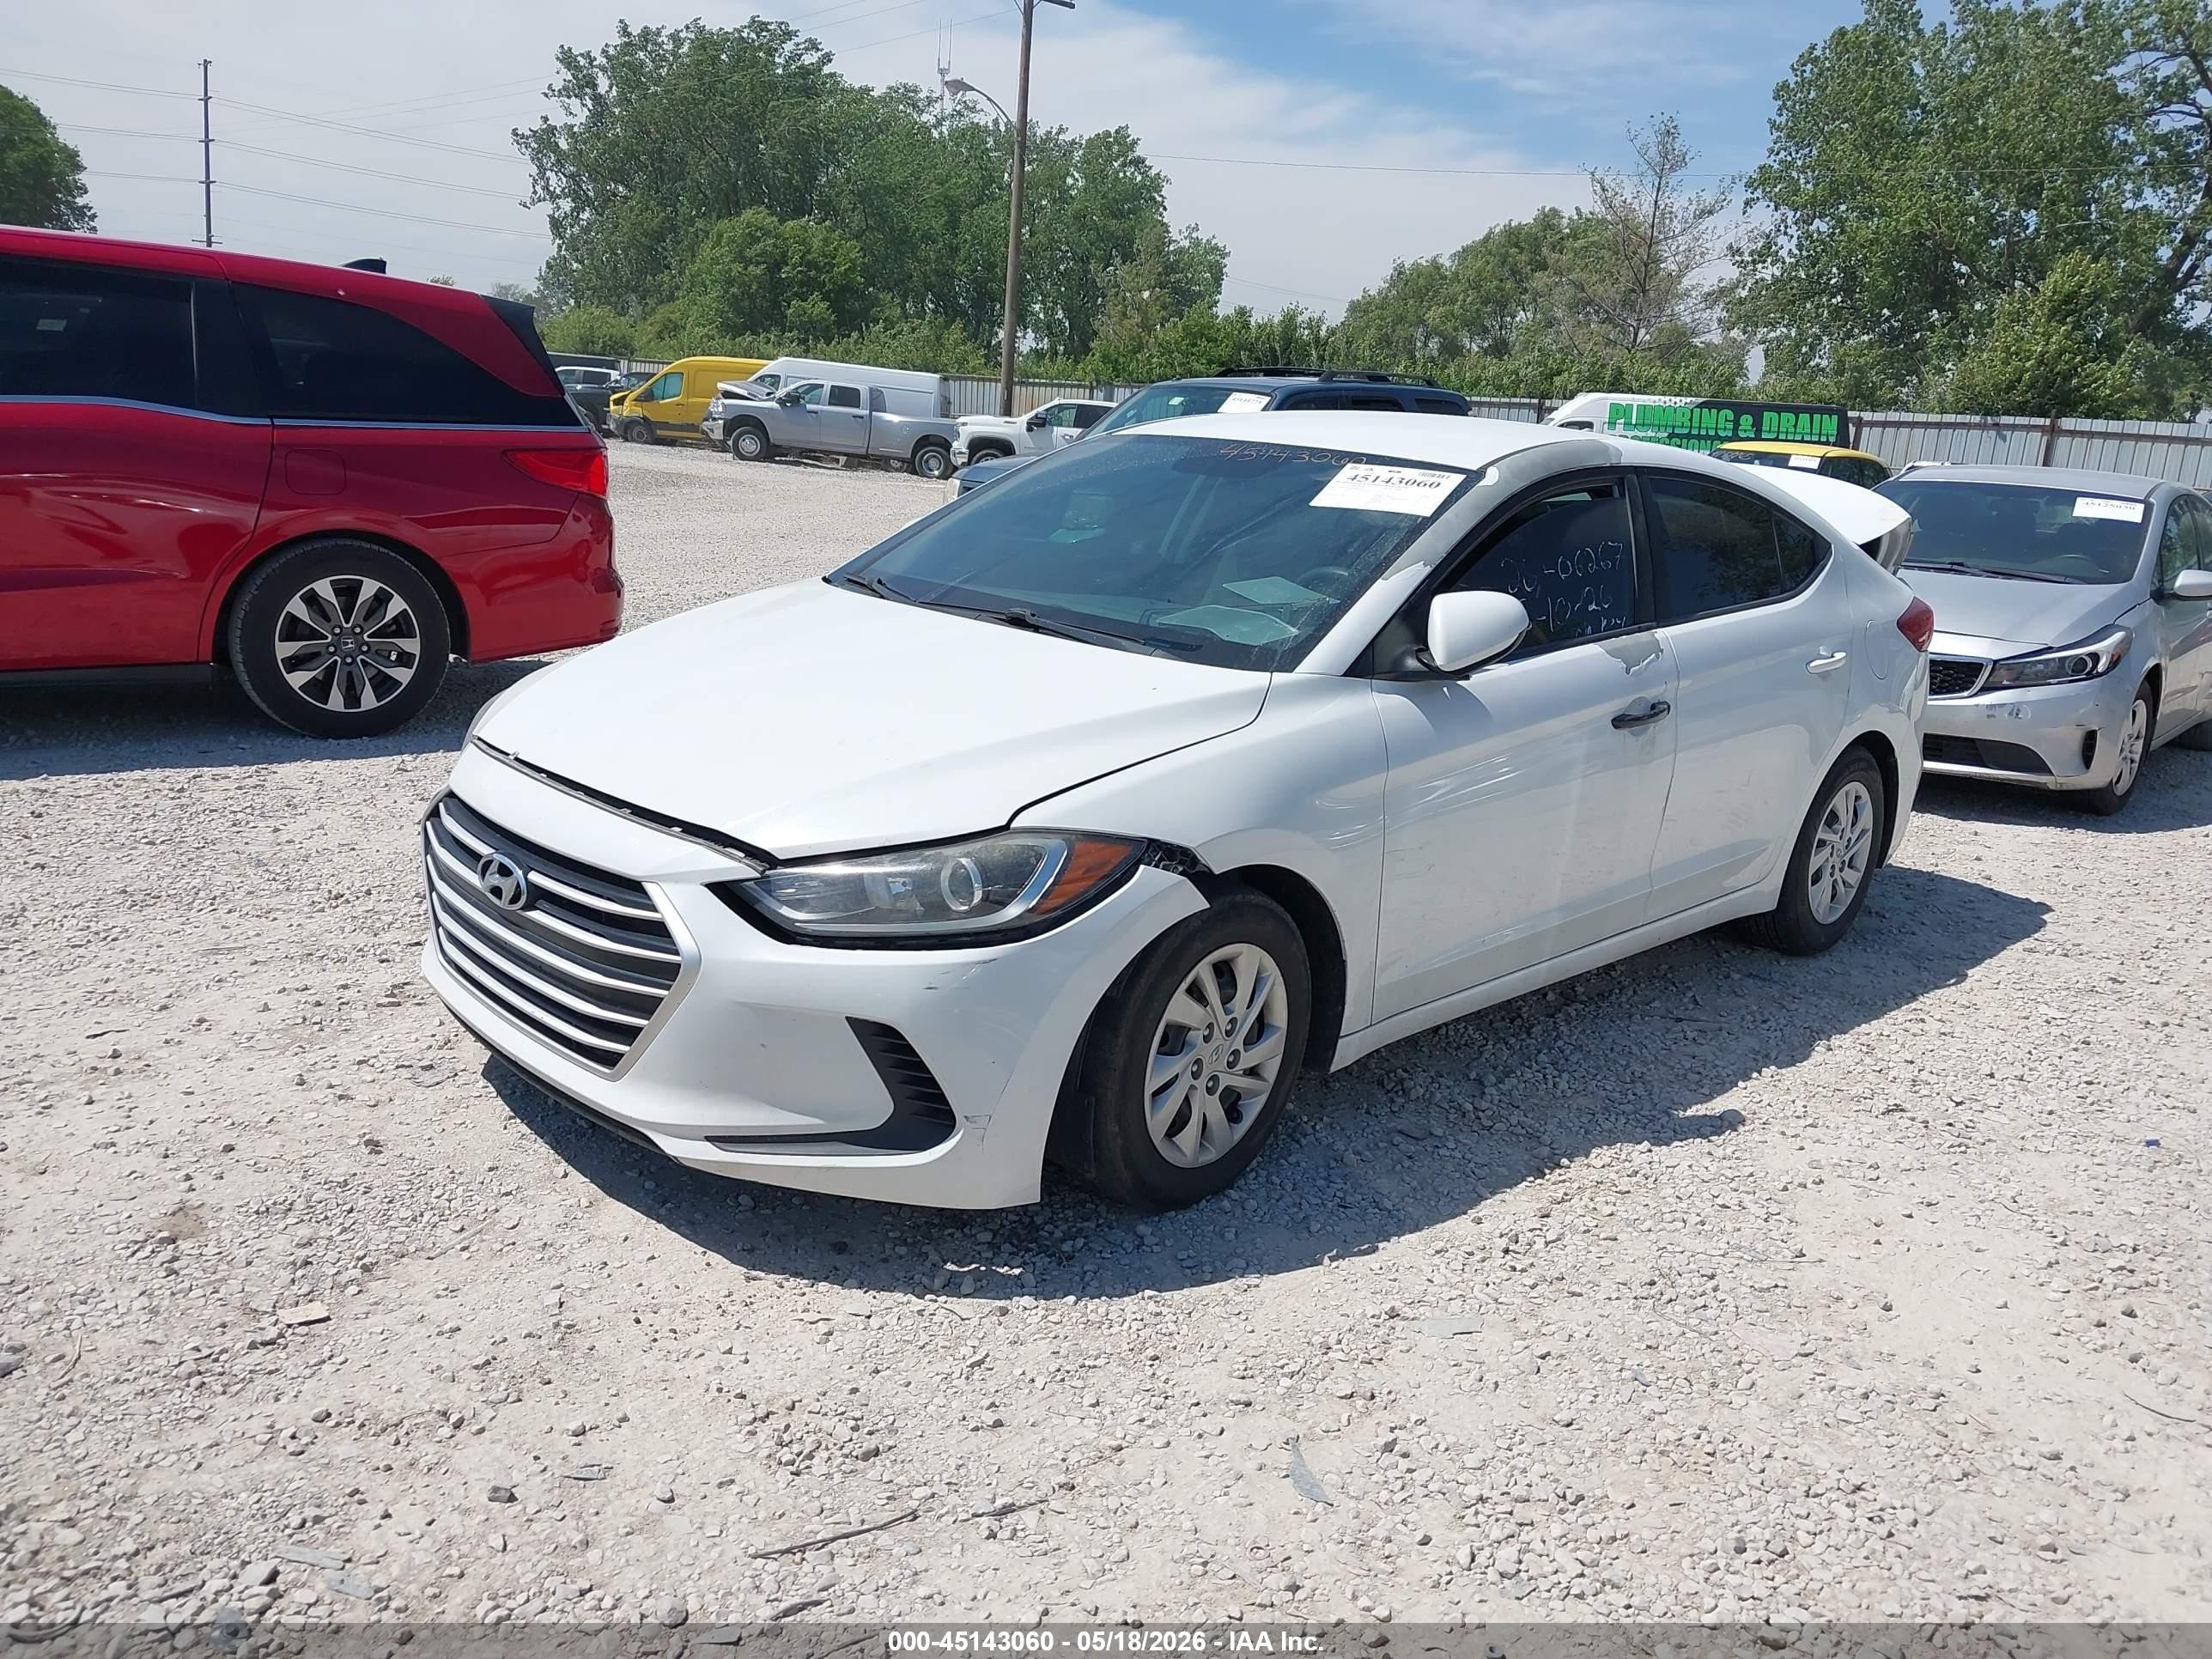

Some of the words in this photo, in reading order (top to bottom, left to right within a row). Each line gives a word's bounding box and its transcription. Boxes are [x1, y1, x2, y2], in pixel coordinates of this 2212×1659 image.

[1607, 403, 1734, 437] PLUMBING
[1739, 415, 1757, 438] &
[1762, 411, 1838, 442] DRAIN
[1346, 473, 1442, 489] 45143060
